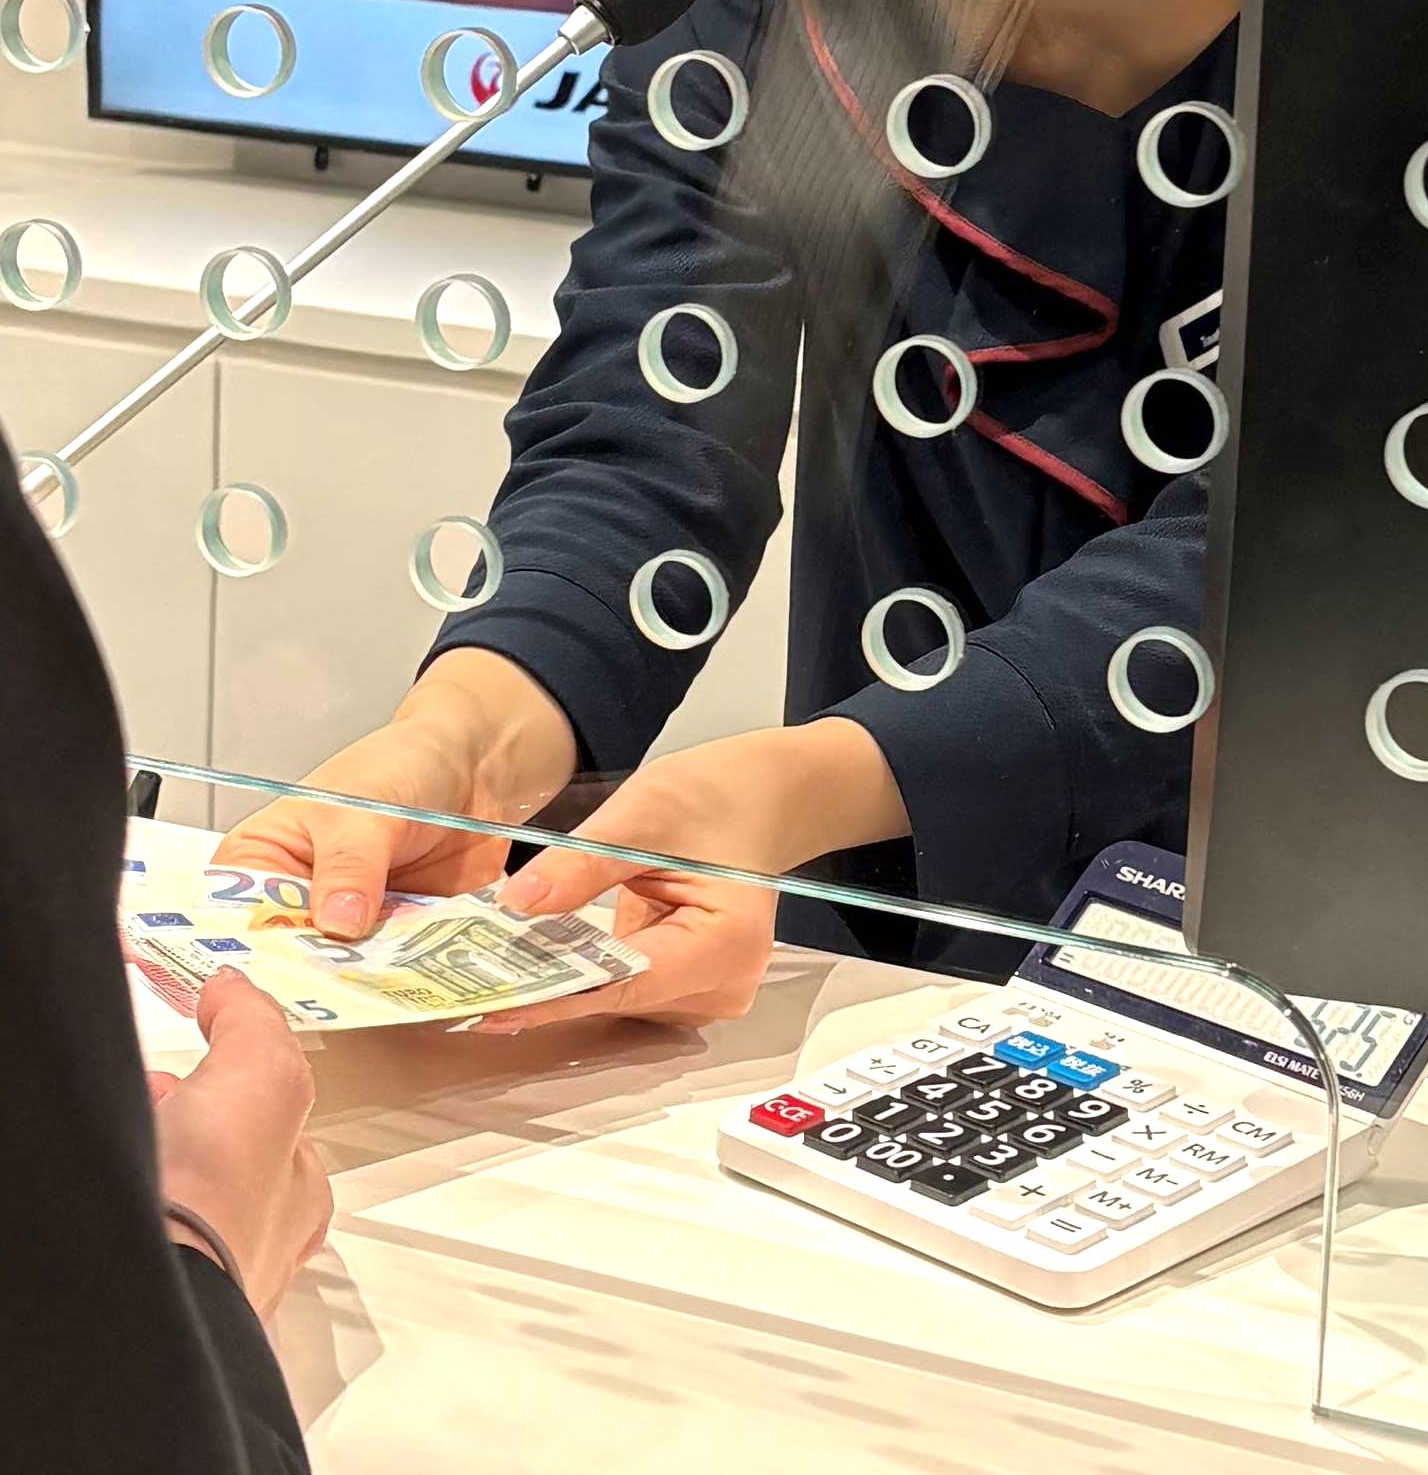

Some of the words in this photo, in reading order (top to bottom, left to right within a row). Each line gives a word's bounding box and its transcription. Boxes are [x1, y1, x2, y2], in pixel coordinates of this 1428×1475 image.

[533, 71, 608, 112] JA
[204, 869, 310, 910] 20
[1115, 866, 1185, 901] SHAR
[295, 934, 365, 964] 5
[295, 999, 339, 1021] 5
[957, 1017, 991, 1034] CA
[911, 1038, 950, 1054] GT
[962, 1057, 1008, 1075] 7
[916, 1082, 958, 1100] 4
[1015, 1079, 1058, 1100] 8
[874, 1102, 909, 1121] 1
[965, 1100, 1013, 1121] 5
[1068, 1100, 1112, 1119] 9
[821, 1123, 862, 1143] 0
[918, 1123, 964, 1146] 2
[1023, 1124, 1067, 1144] 6
[1231, 1120, 1277, 1142] CM
[865, 1141, 923, 1168] 00
[973, 1144, 1019, 1166] 3
[1181, 1143, 1231, 1166] RM
